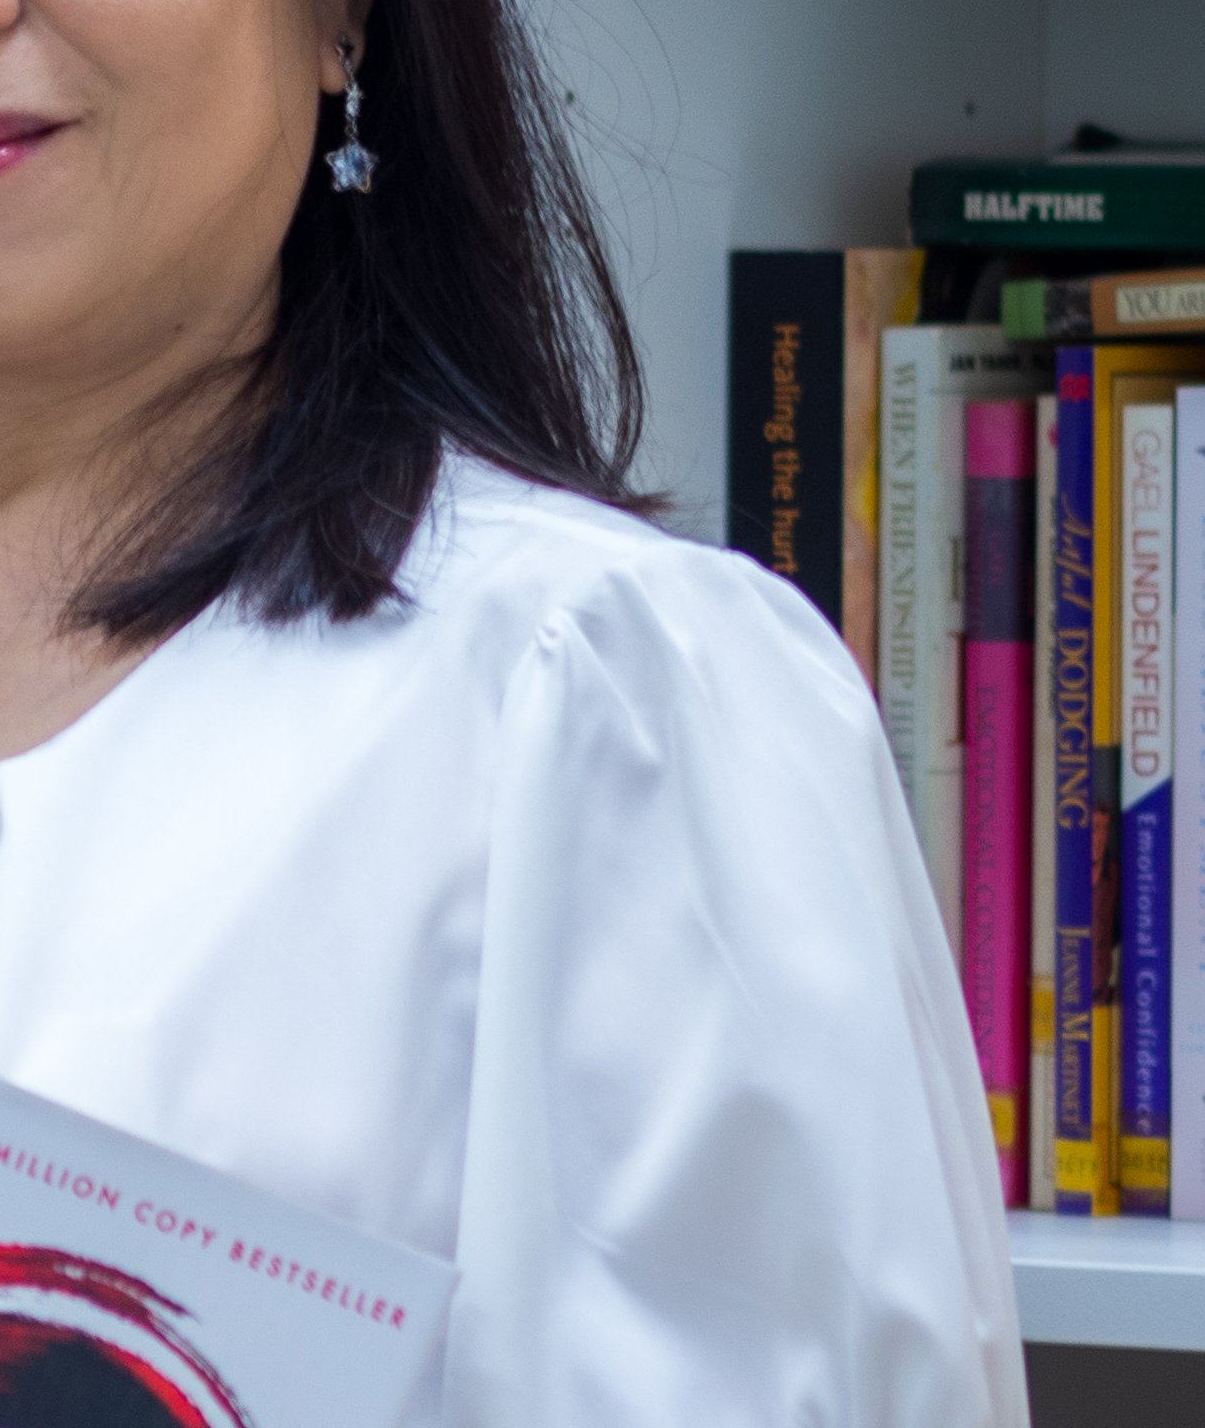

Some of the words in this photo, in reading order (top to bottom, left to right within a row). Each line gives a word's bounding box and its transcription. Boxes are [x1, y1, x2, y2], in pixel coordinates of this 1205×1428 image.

[963, 190, 1105, 222] HALFTIME
[1122, 285, 1171, 320] YOU
[764, 323, 802, 443] Healing
[889, 362, 917, 470] WHEN
[771, 451, 802, 502] the
[1131, 428, 1162, 523] GAEL
[771, 509, 802, 576] hurt
[890, 481, 917, 691] FRIENDSHIP
[1057, 490, 1092, 610] Artful
[1131, 529, 1161, 778] LINDENFIELD
[973, 685, 995, 881] EMOTIONAL
[1057, 627, 1090, 830] DODGING
[1135, 813, 1158, 958] Emotional
[1056, 926, 1090, 1006] JEANNE
[1135, 972, 1158, 1134] Confidence
[133, 1200, 217, 1250] COPY
[229, 1239, 408, 1332] BESTSELLER
